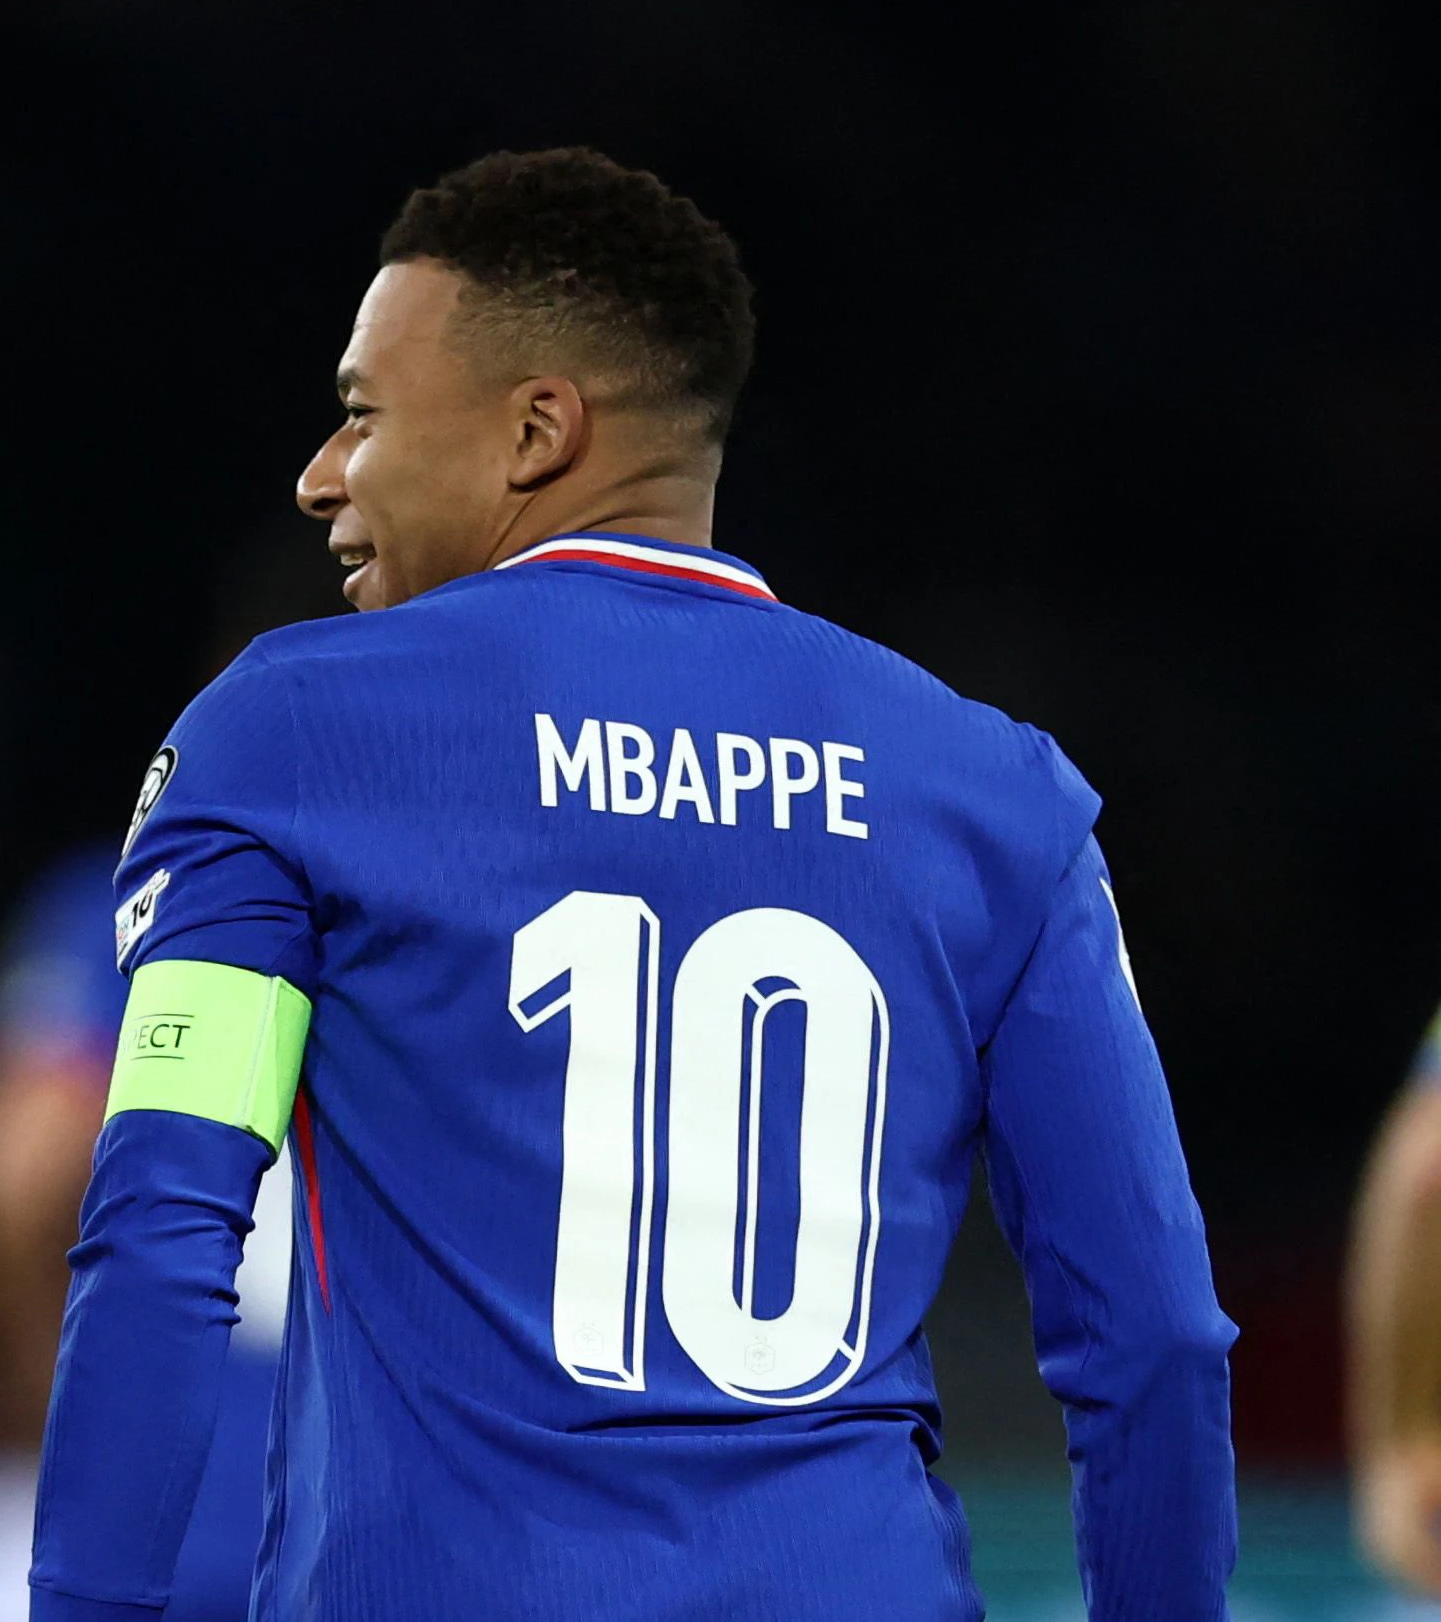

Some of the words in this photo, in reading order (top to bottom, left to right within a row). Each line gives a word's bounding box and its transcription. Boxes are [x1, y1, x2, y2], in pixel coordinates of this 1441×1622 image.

[534, 713, 868, 840] MBAPPE
[132, 891, 153, 928] 10
[508, 890, 890, 1407] 10
